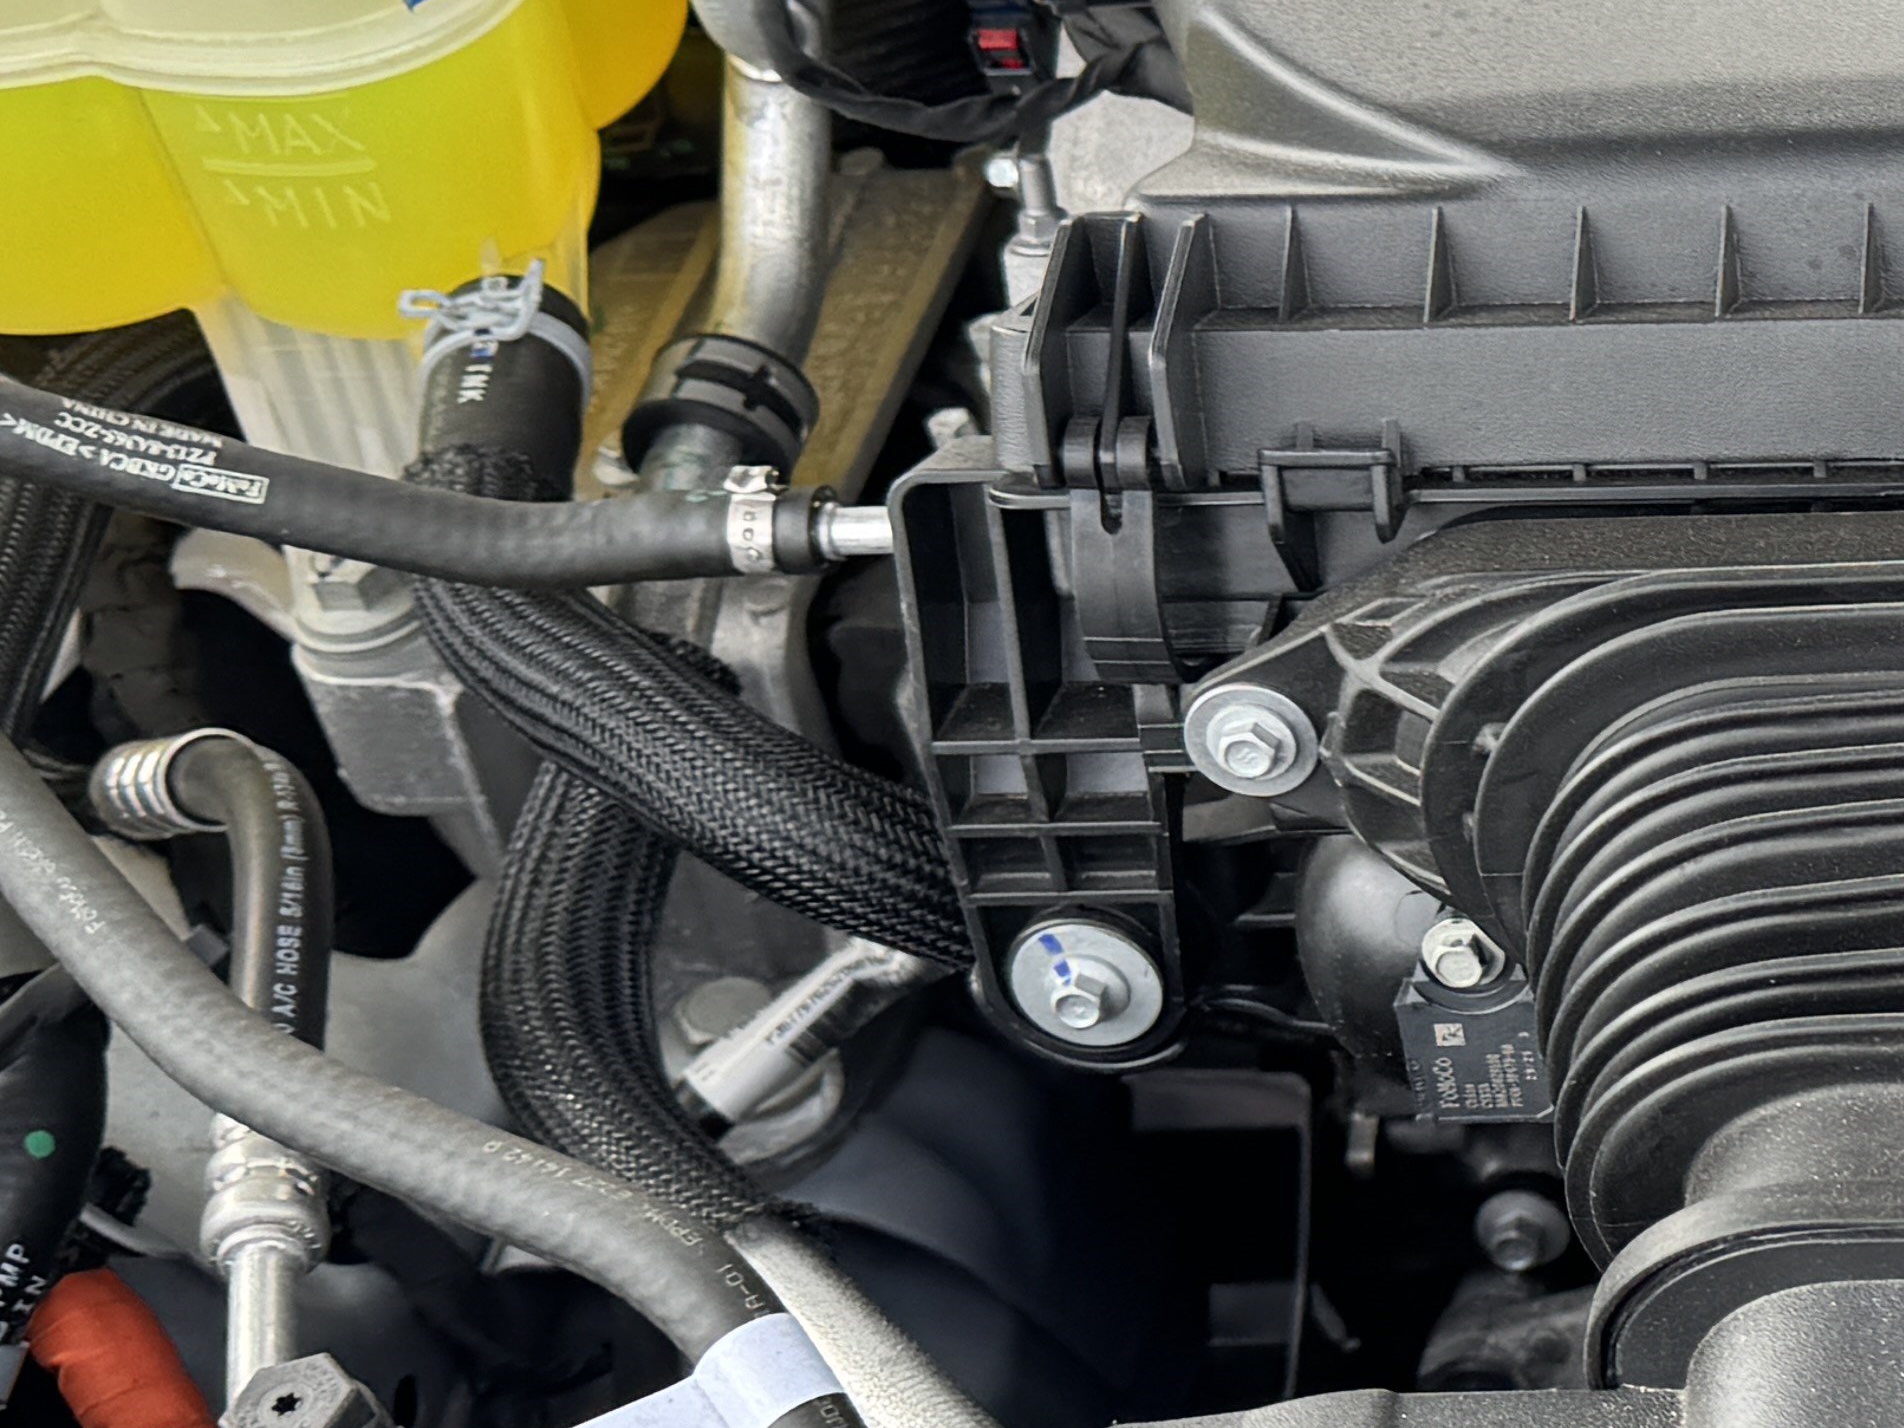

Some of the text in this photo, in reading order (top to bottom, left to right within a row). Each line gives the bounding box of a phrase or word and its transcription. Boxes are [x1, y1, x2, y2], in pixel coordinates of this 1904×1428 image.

[227, 107, 366, 155] MAX
[252, 182, 391, 229] MIN
[274, 924, 303, 976] HOSE
[271, 981, 298, 1019] A/C
[1432, 1057, 1460, 1109] FoMoCo
